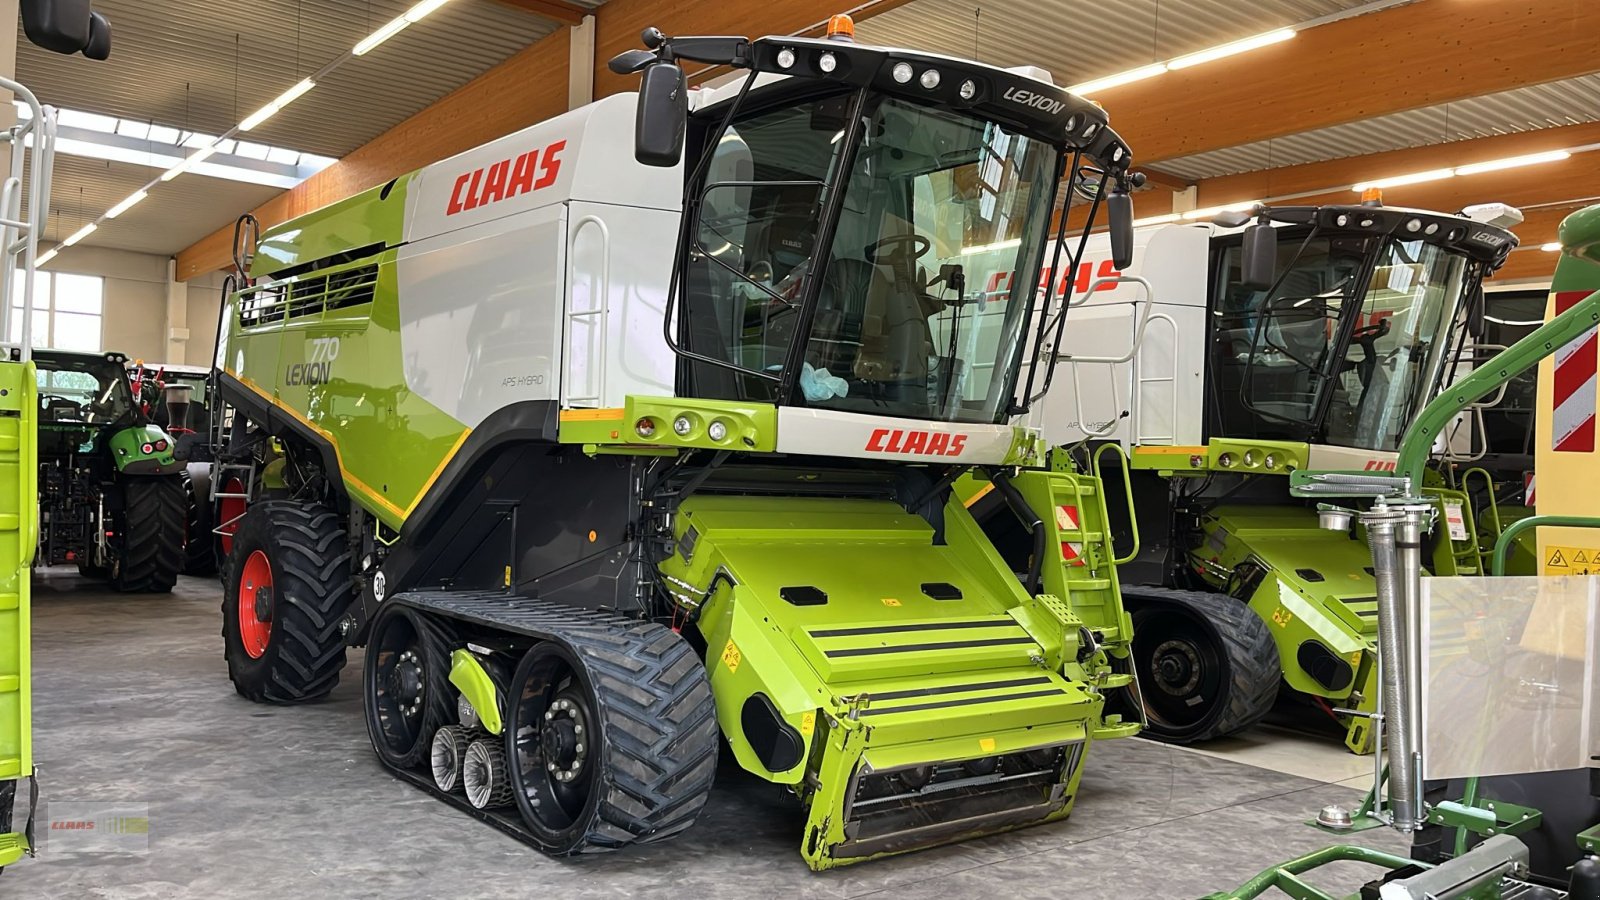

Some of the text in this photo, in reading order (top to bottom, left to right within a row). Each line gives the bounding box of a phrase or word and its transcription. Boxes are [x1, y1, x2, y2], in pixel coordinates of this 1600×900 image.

[1003, 87, 1065, 115] LEXION
[447, 140, 566, 215] CLAAS
[1472, 231, 1504, 247] LEXION
[311, 336, 340, 361] 770
[285, 361, 331, 386] LEXION
[501, 374, 544, 387] APS HYBRID
[865, 429, 967, 456] CLAAS
[375, 576, 384, 596] 30
